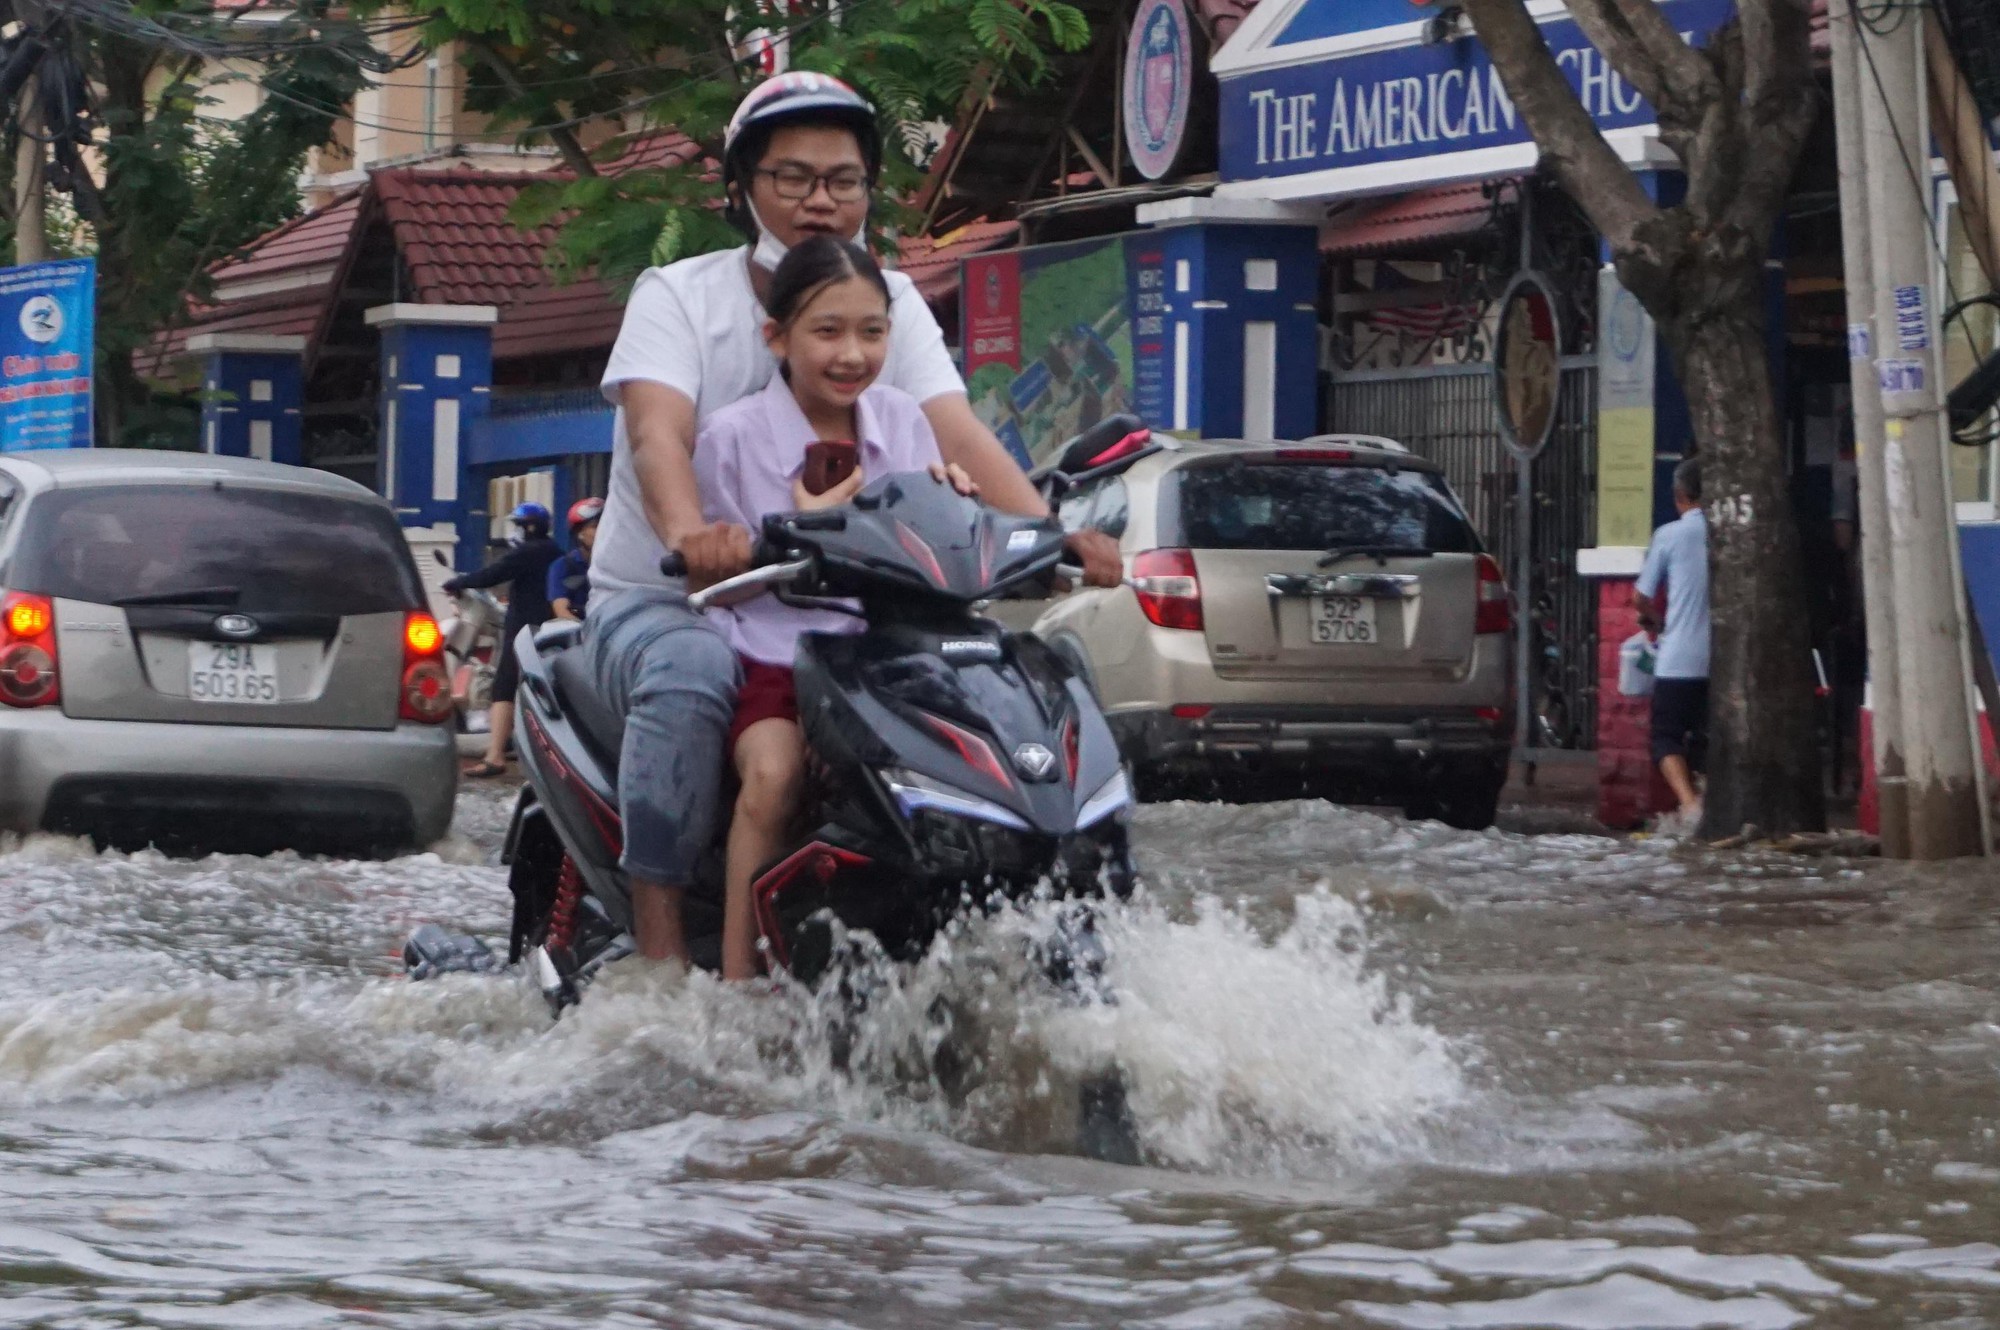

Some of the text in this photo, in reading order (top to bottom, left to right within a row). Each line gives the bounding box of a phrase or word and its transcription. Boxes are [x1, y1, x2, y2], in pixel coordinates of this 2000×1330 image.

[1250, 89, 1316, 164] THE
[1324, 63, 1515, 156] AMERICAN
[1318, 619, 1370, 640] 5706
[941, 641, 997, 651] HONDA
